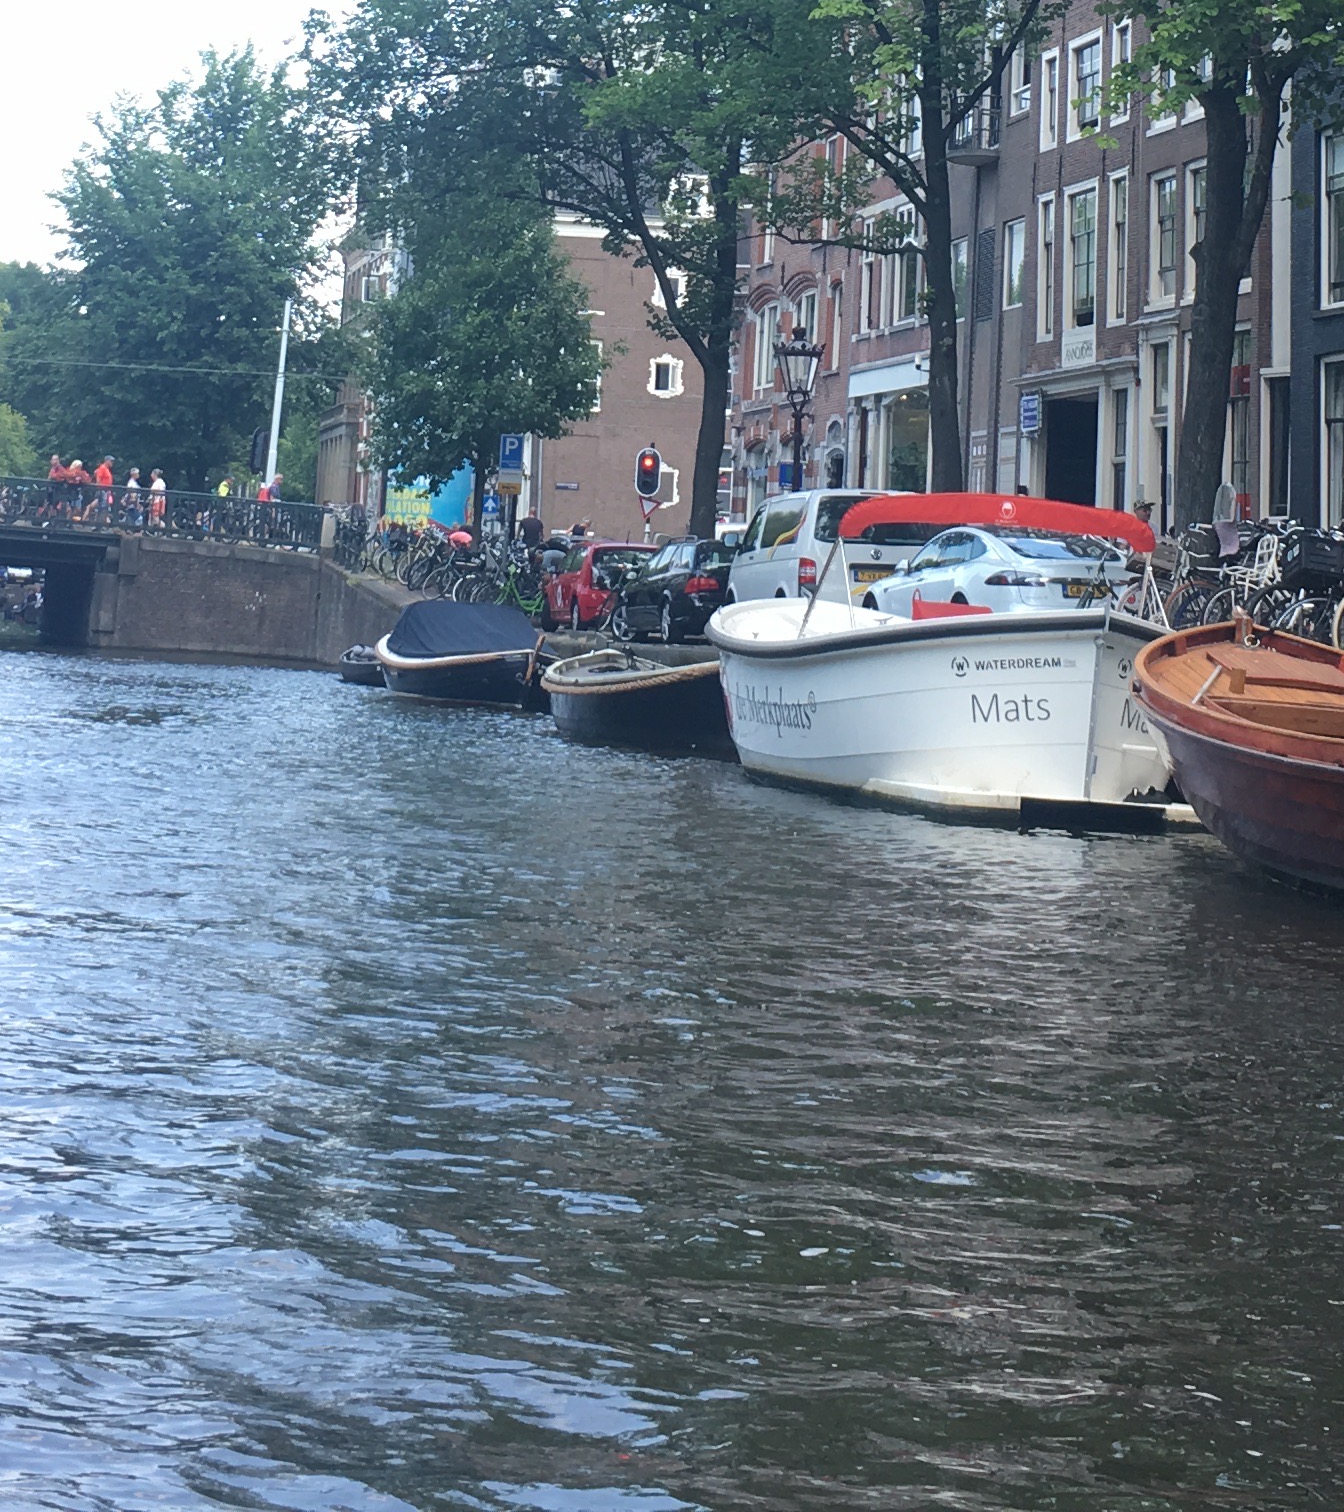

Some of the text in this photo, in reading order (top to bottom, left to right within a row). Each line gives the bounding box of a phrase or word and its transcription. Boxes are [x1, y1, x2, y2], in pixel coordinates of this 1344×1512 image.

[505, 437, 519, 455] P
[974, 657, 1061, 671] WATERDREAM
[971, 693, 1051, 723] Mats
